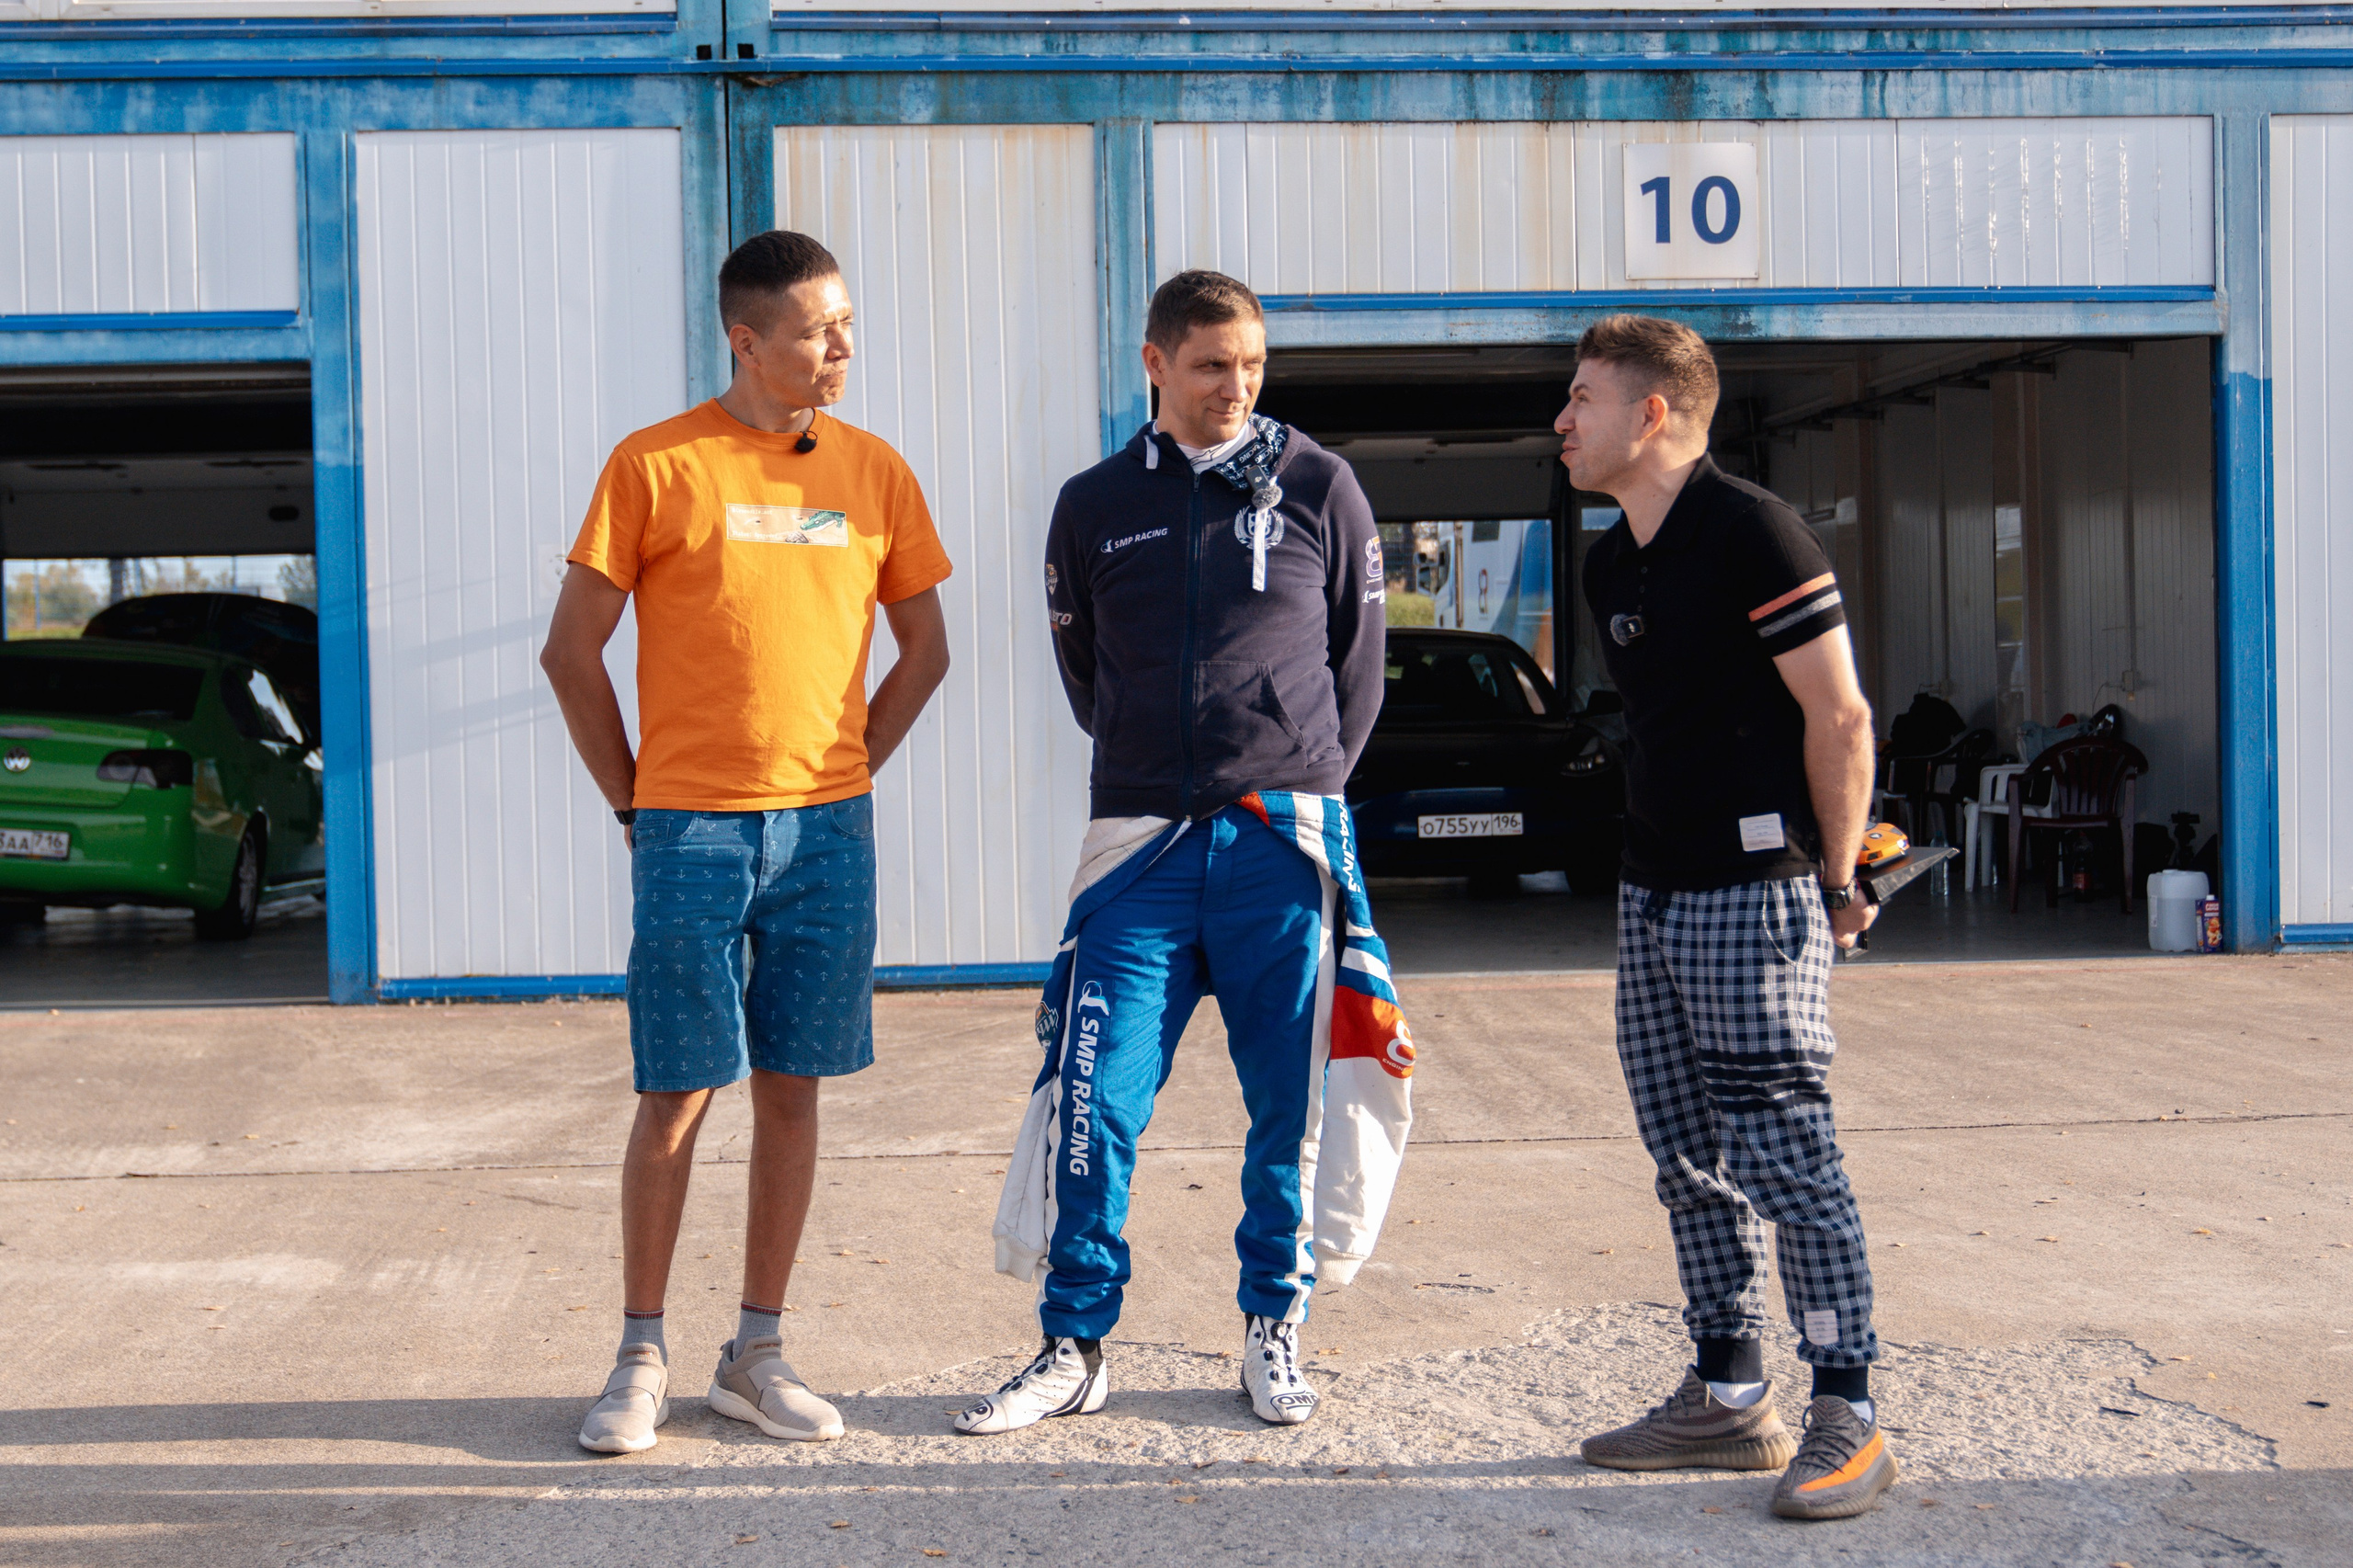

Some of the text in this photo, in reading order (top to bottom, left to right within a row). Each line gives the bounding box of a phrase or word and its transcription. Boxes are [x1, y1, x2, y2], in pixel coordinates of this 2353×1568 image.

[1641, 175, 1741, 244] 10
[1114, 528, 1168, 549] SMP RACING
[1493, 814, 1518, 828] 196
[1069, 1017, 1099, 1176] SMP RACING
